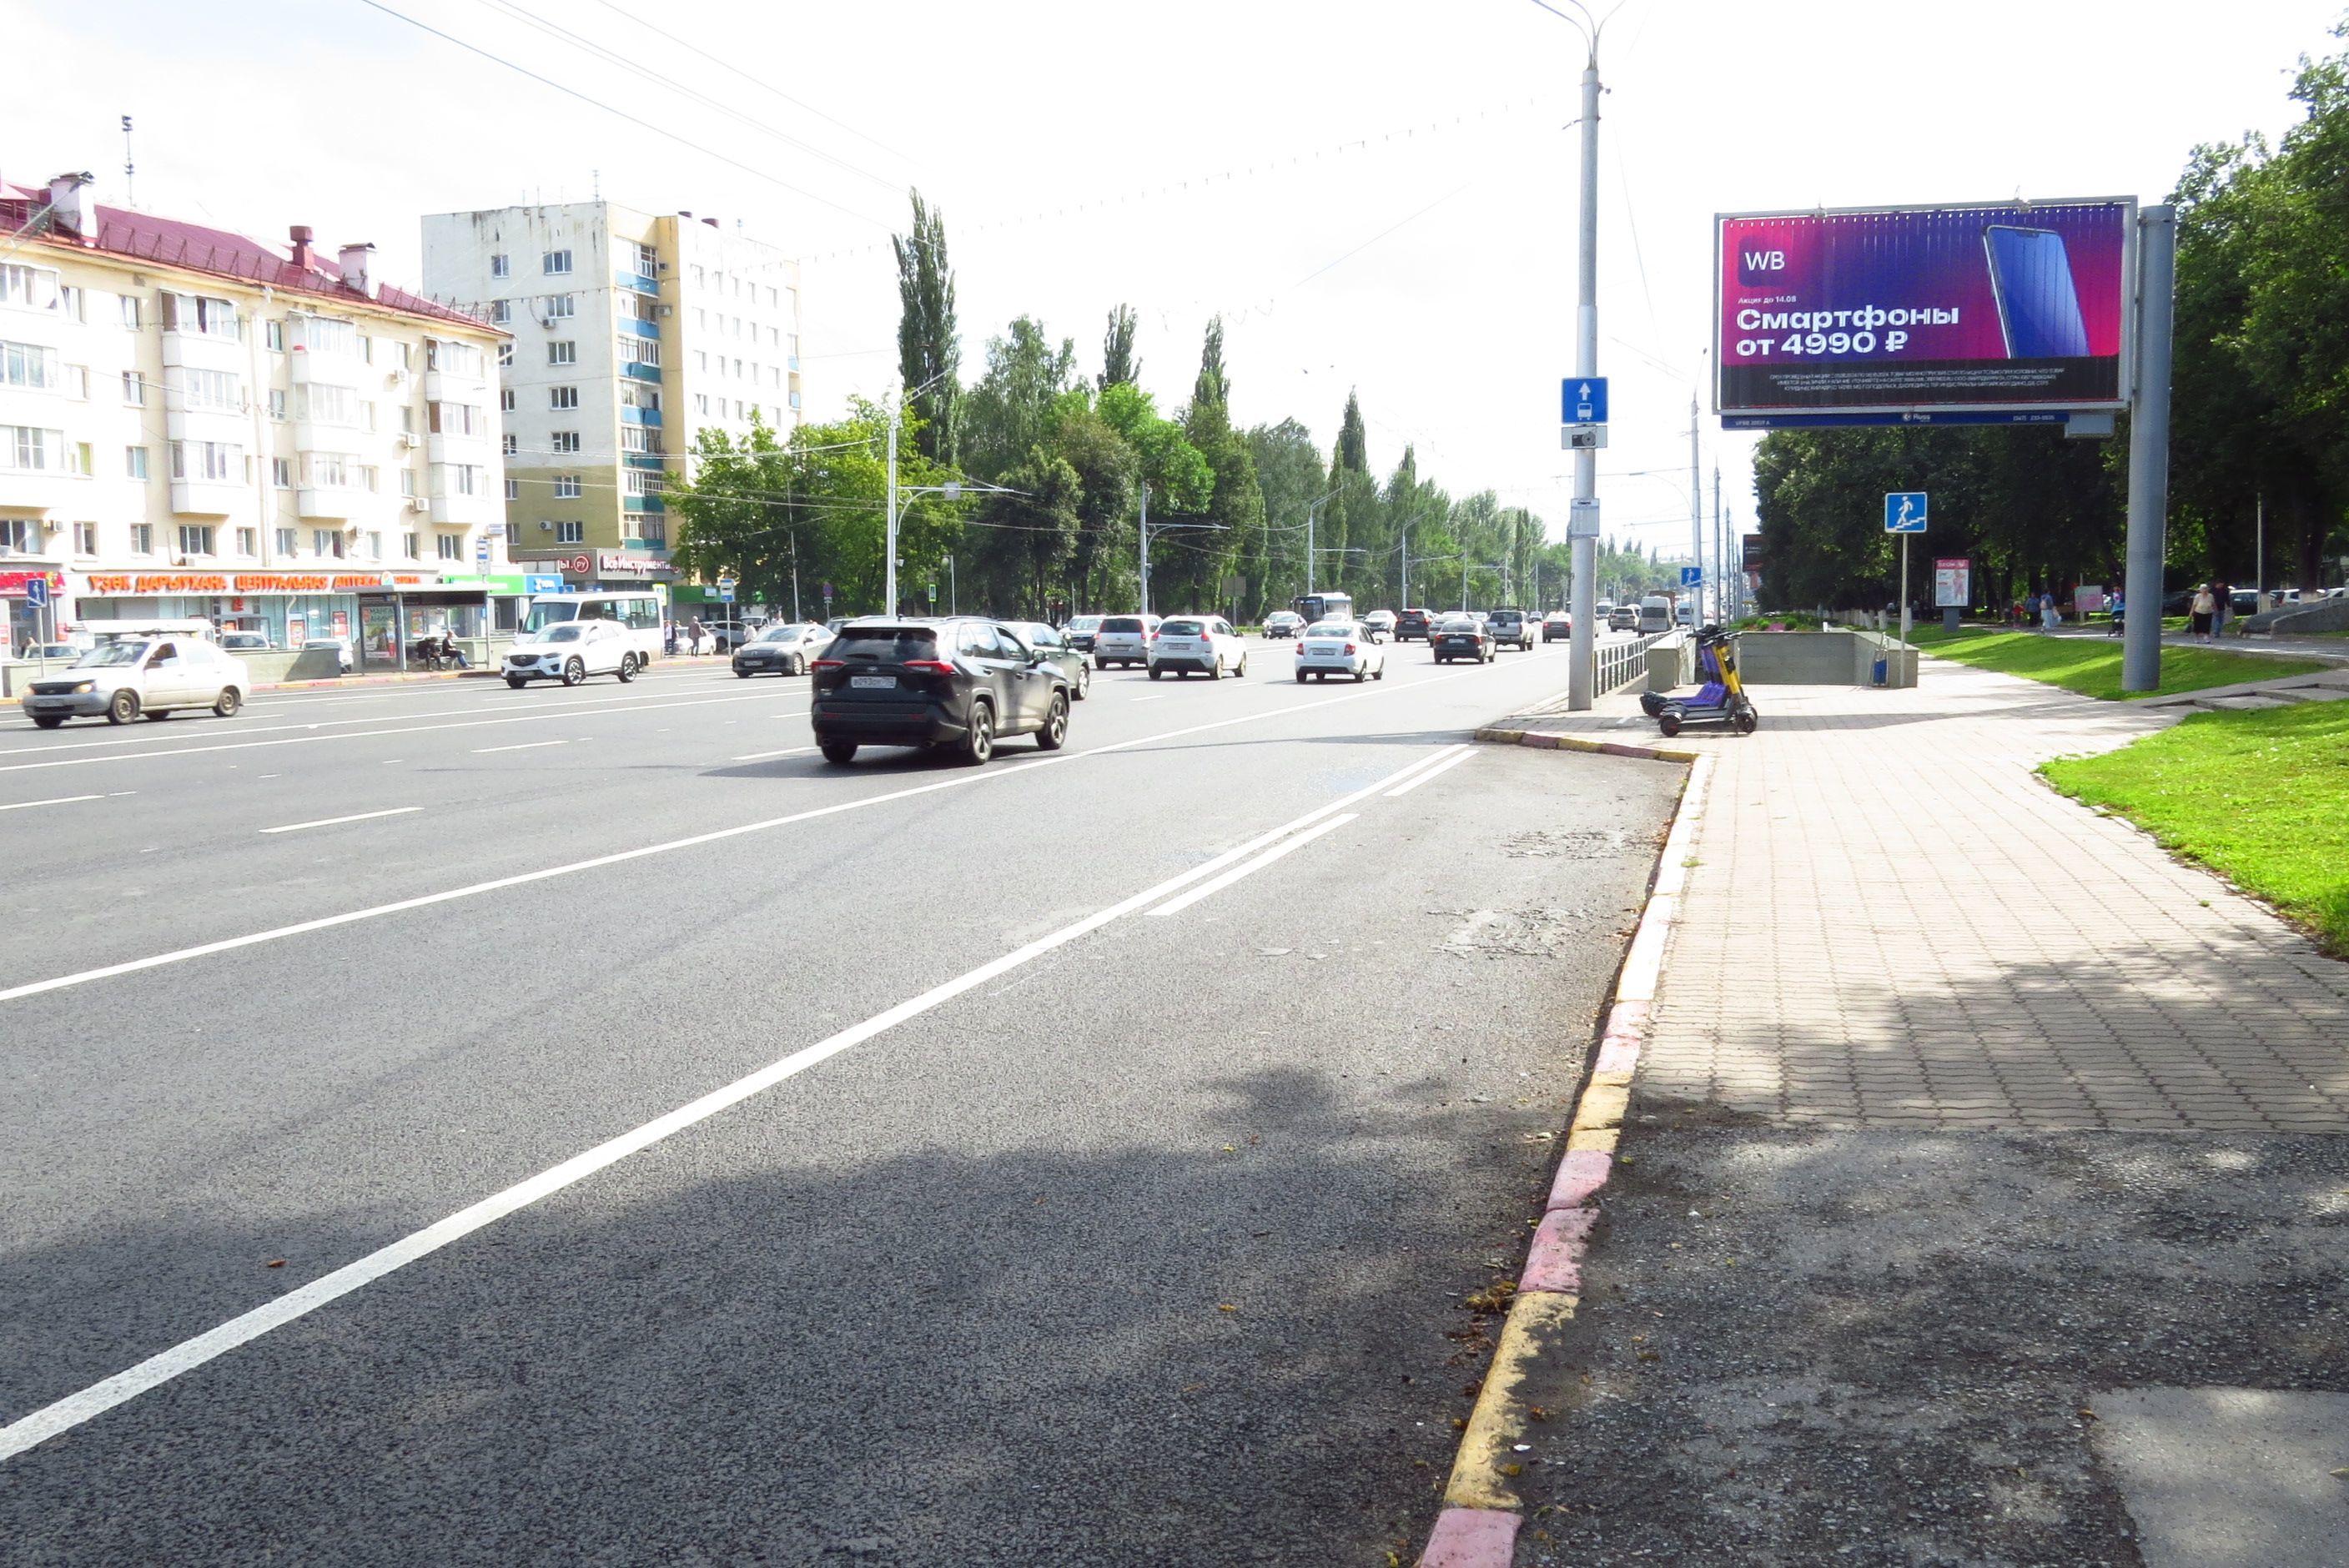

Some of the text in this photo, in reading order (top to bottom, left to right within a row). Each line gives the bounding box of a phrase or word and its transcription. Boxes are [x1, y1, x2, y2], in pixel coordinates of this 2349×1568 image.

[1744, 251, 1785, 271] WB
[1736, 304, 1959, 332] Смартфоны
[1736, 339, 1775, 357] от
[1781, 331, 1877, 355] 4990
[234, 575, 329, 591] ЦЕНТРАЛЬНАЯ
[334, 575, 380, 587] АПТЕКА
